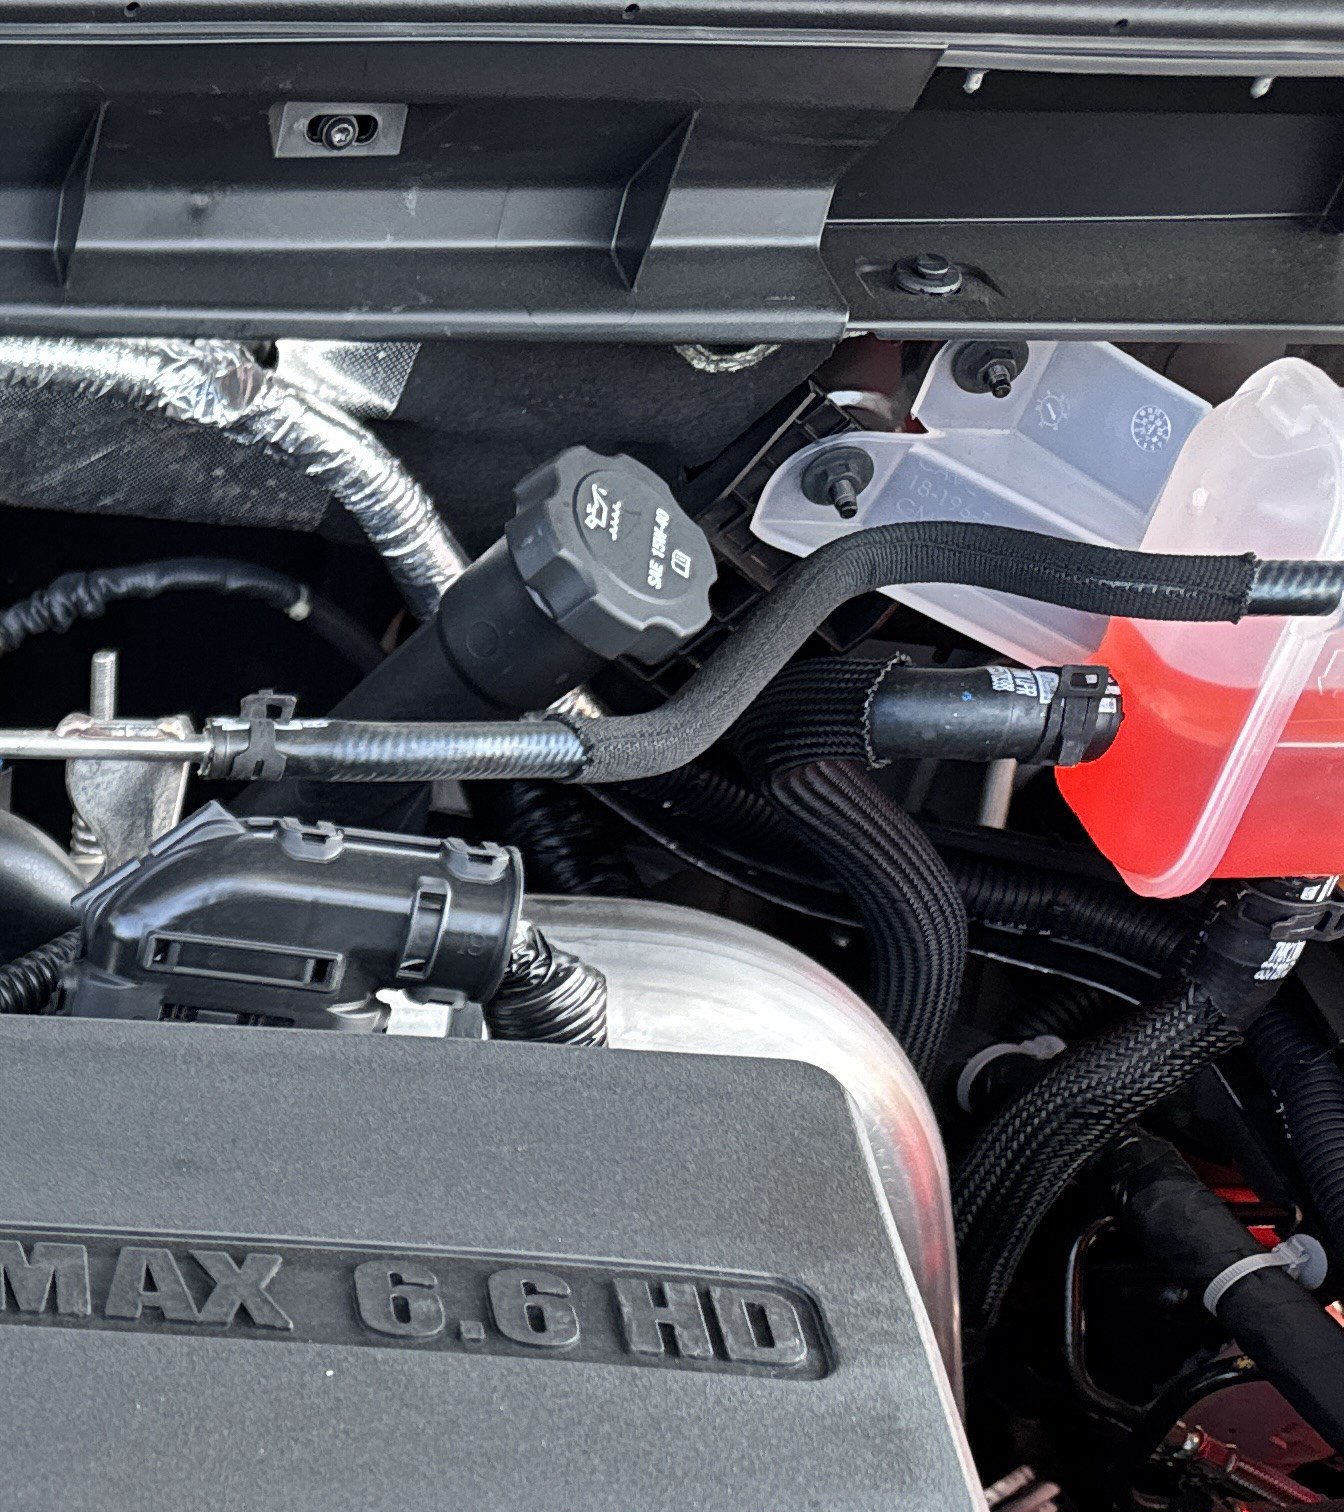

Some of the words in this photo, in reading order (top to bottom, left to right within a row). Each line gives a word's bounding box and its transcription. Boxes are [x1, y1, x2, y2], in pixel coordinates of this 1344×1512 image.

[651, 507, 670, 559] 15W-40
[647, 558, 664, 590] SAE
[353, 1259, 582, 1348] 6.6
[612, 1276, 808, 1366] HD
